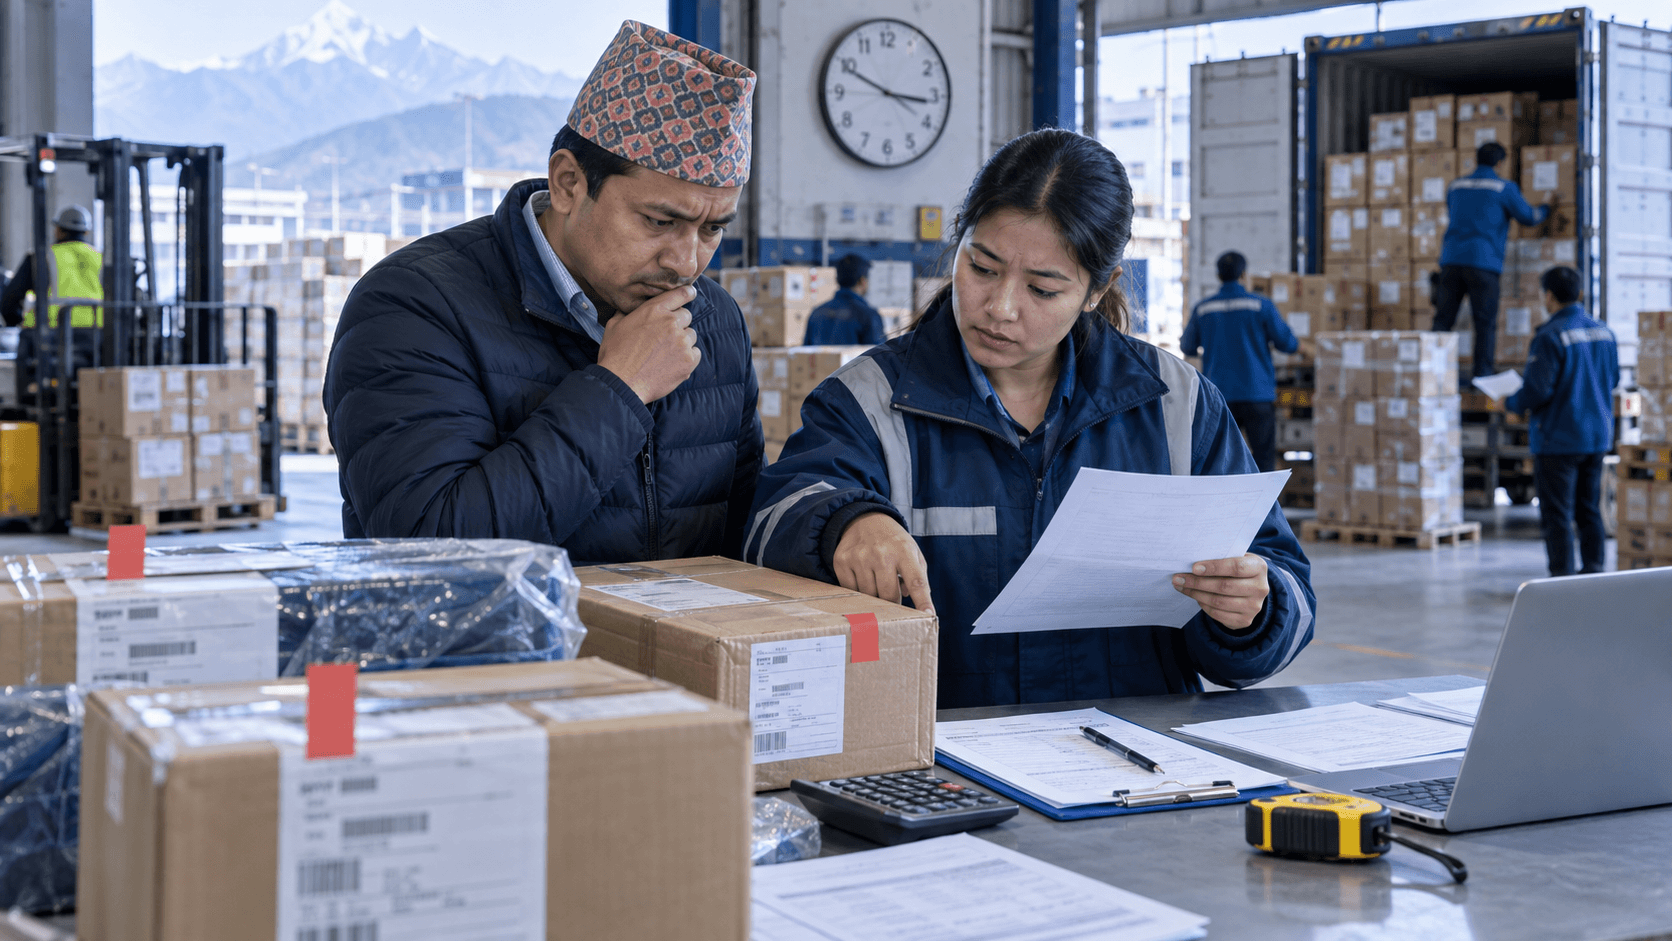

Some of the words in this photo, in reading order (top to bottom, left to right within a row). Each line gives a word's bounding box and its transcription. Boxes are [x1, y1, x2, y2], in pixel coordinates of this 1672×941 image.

[858, 38, 870, 54] 11
[880, 31, 896, 48] 12
[841, 57, 857, 75] 10
[922, 59, 933, 77] 2
[834, 83, 845, 101] 9
[929, 86, 940, 104] 3
[841, 110, 853, 129] 8
[921, 113, 932, 130] 4
[861, 131, 871, 148] 7
[881, 138, 893, 156] 6
[905, 132, 916, 150] 5
